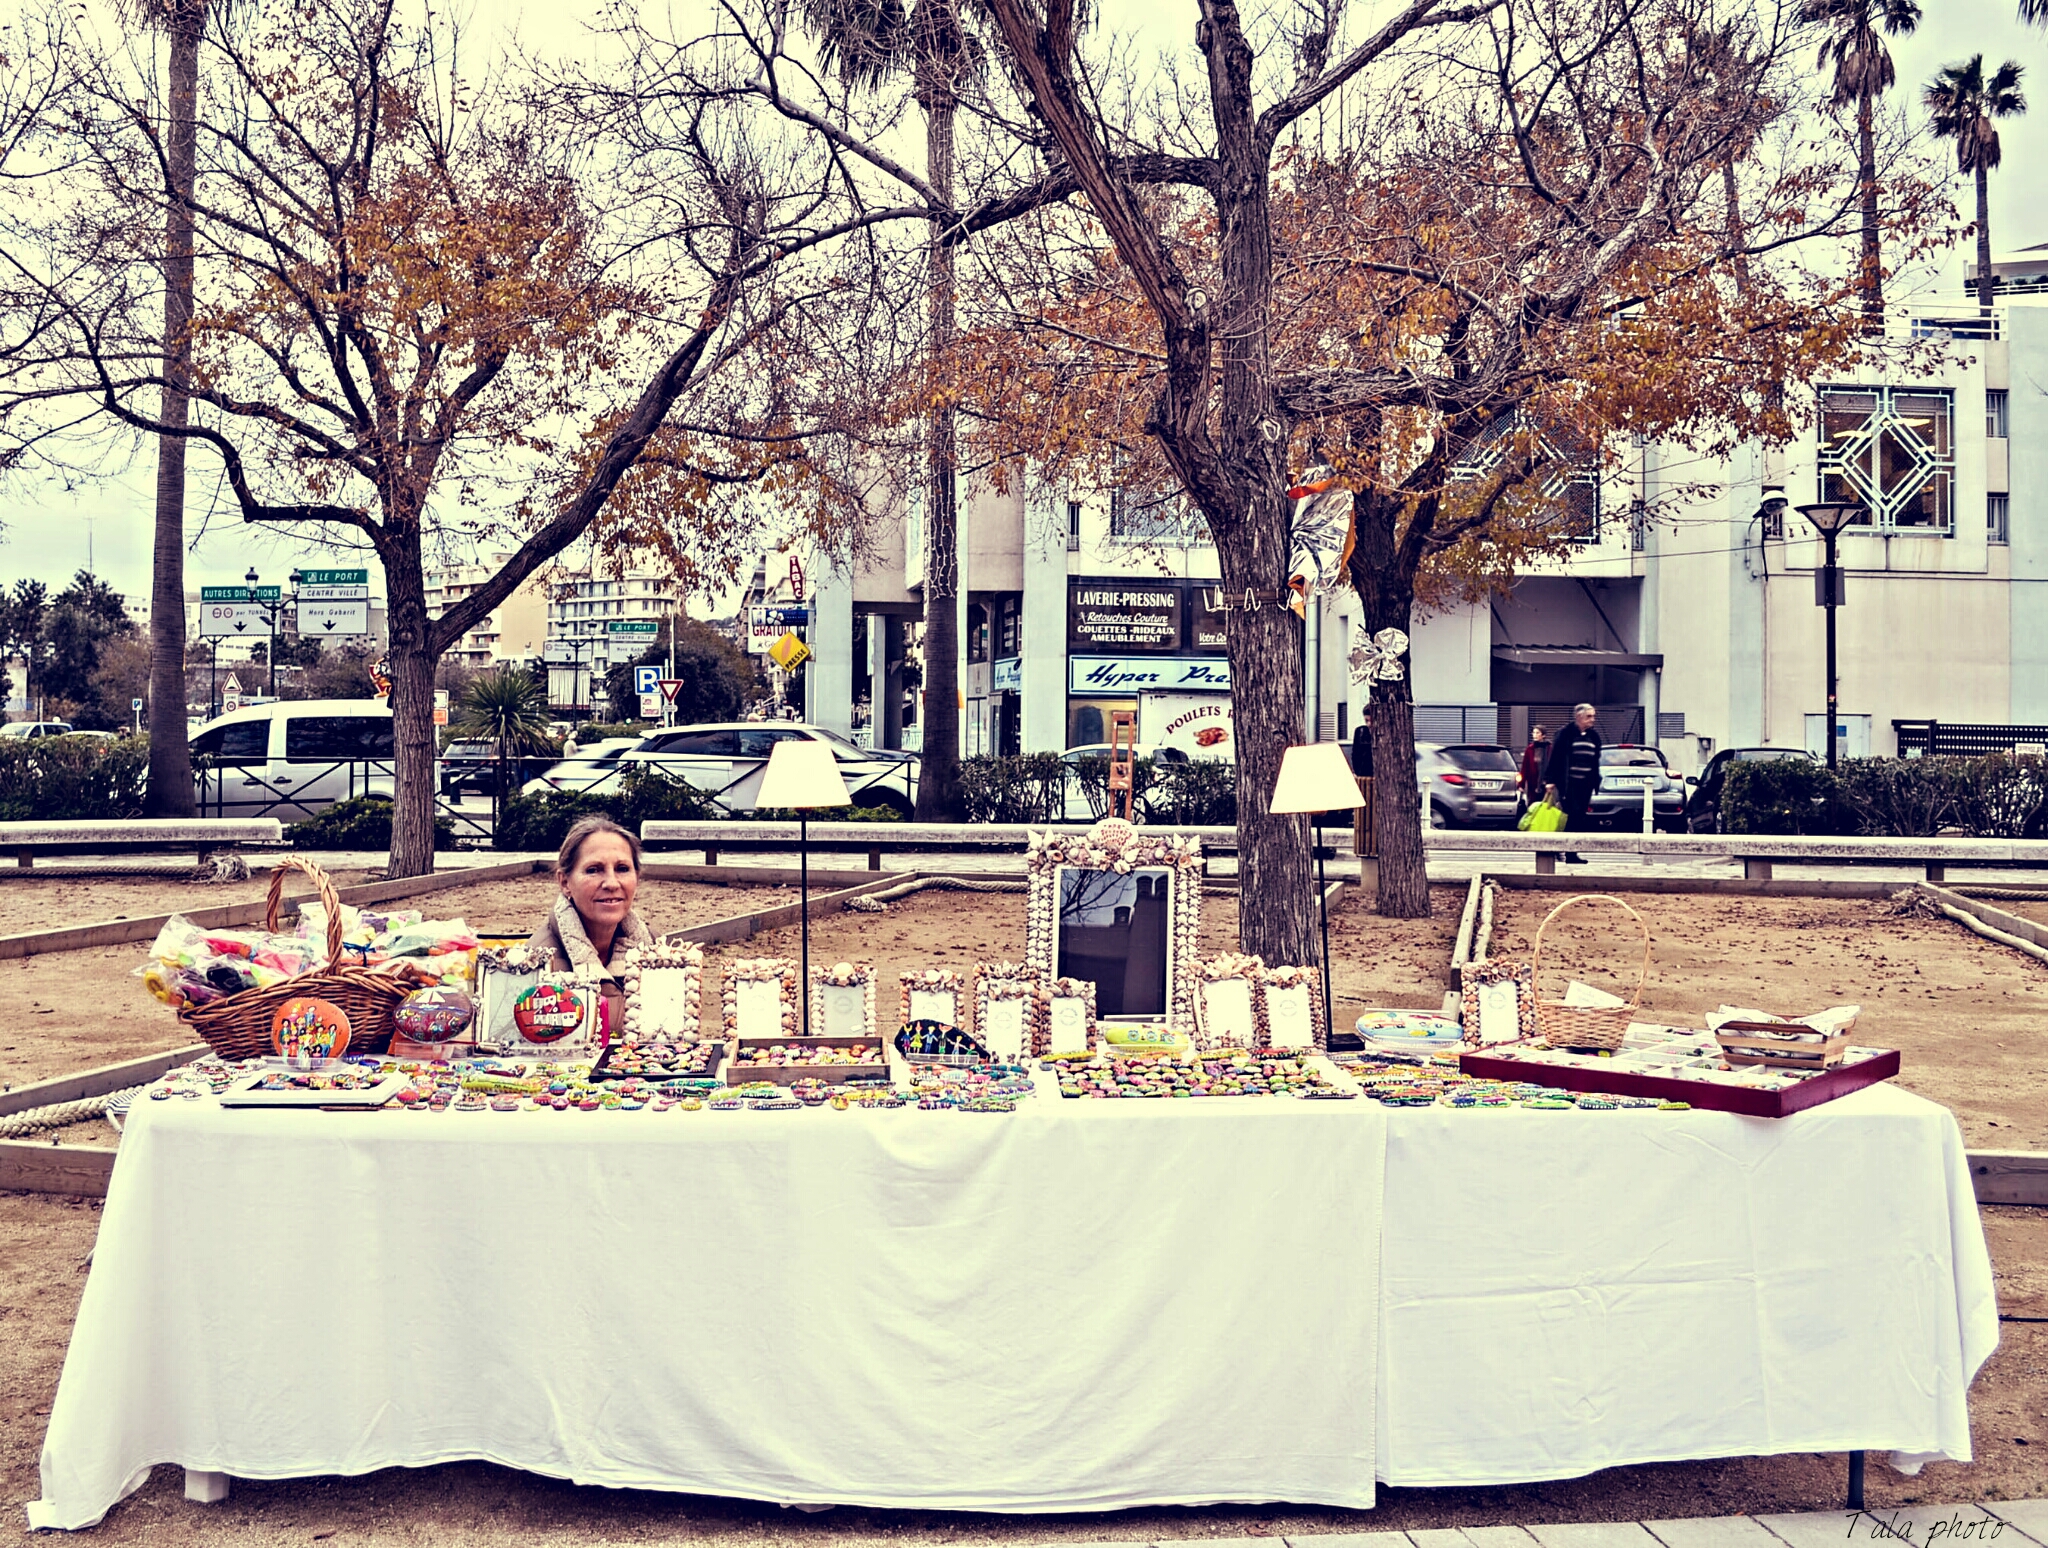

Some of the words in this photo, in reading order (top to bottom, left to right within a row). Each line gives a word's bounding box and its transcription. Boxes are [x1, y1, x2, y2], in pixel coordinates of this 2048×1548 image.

[319, 573, 329, 581] LE
[335, 572, 358, 581] PORT
[790, 557, 802, 597] TABAC
[204, 589, 232, 598] AUTRES
[339, 589, 358, 597] VILLE
[1087, 611, 1132, 623] Retouches
[1134, 612, 1169, 623] Couture
[1077, 625, 1127, 634] COUETTES
[1090, 634, 1162, 643] AMEUBLEMENT
[1198, 632, 1216, 643] Votre
[784, 648, 807, 670] PRESSE
[1086, 663, 1160, 687] Hyper
[1178, 666, 1231, 683] Pre
[1166, 705, 1221, 735] POULETS
